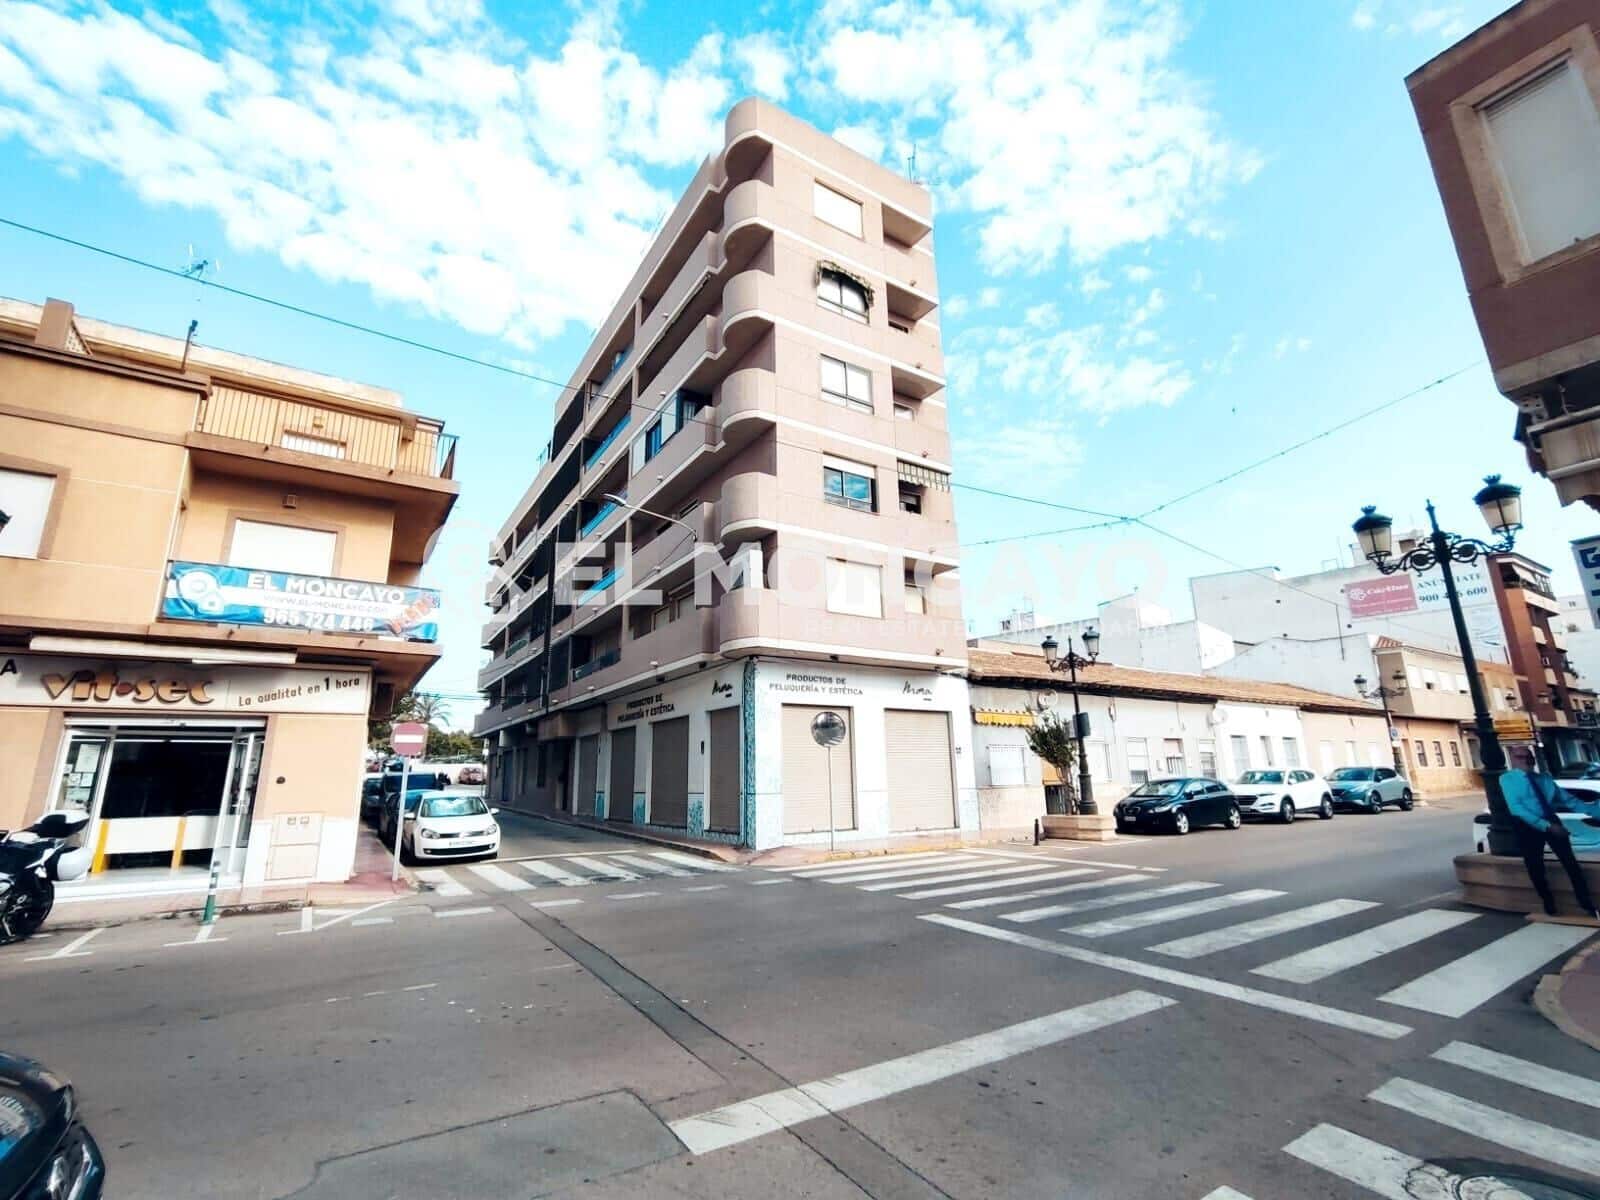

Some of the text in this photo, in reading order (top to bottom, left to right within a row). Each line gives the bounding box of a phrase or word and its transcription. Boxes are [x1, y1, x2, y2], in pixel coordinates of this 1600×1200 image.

[248, 571, 279, 591] EL
[286, 575, 405, 602] MONCAYO
[264, 607, 374, 632] 965 724 446
[238, 695, 252, 707] La
[307, 685, 320, 695] en
[323, 675, 331, 692] 1
[335, 676, 360, 689] hora
[769, 682, 820, 693] PELUQUERÍA
[828, 685, 864, 696] ESTÉTICA
[786, 673, 848, 685] PRODUCTOS DE
